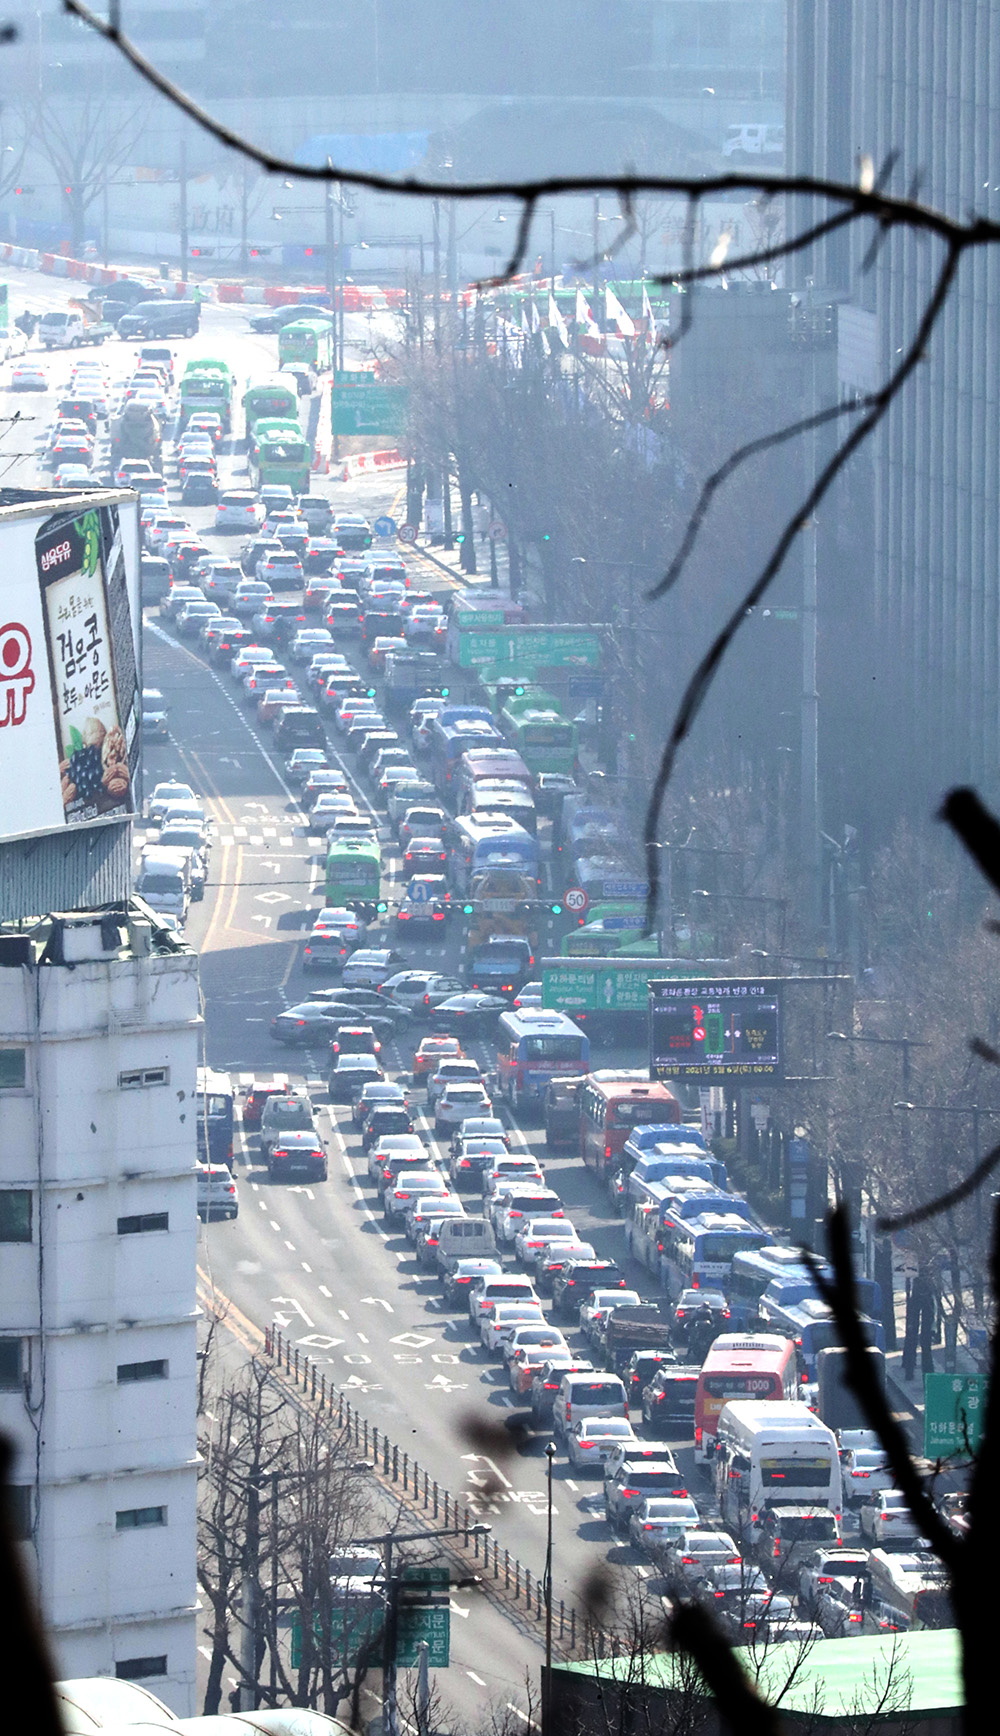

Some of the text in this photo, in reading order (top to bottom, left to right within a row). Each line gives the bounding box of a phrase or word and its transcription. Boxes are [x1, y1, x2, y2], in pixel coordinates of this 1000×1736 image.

[41, 540, 72, 571] 삼육두유
[56, 612, 103, 679] 검은콩
[0, 622, 36, 728] 유
[84, 670, 109, 700] 아몬드
[568, 894, 584, 906] 50
[393, 1353, 461, 1365] 50
[747, 1380, 770, 1391] 1000
